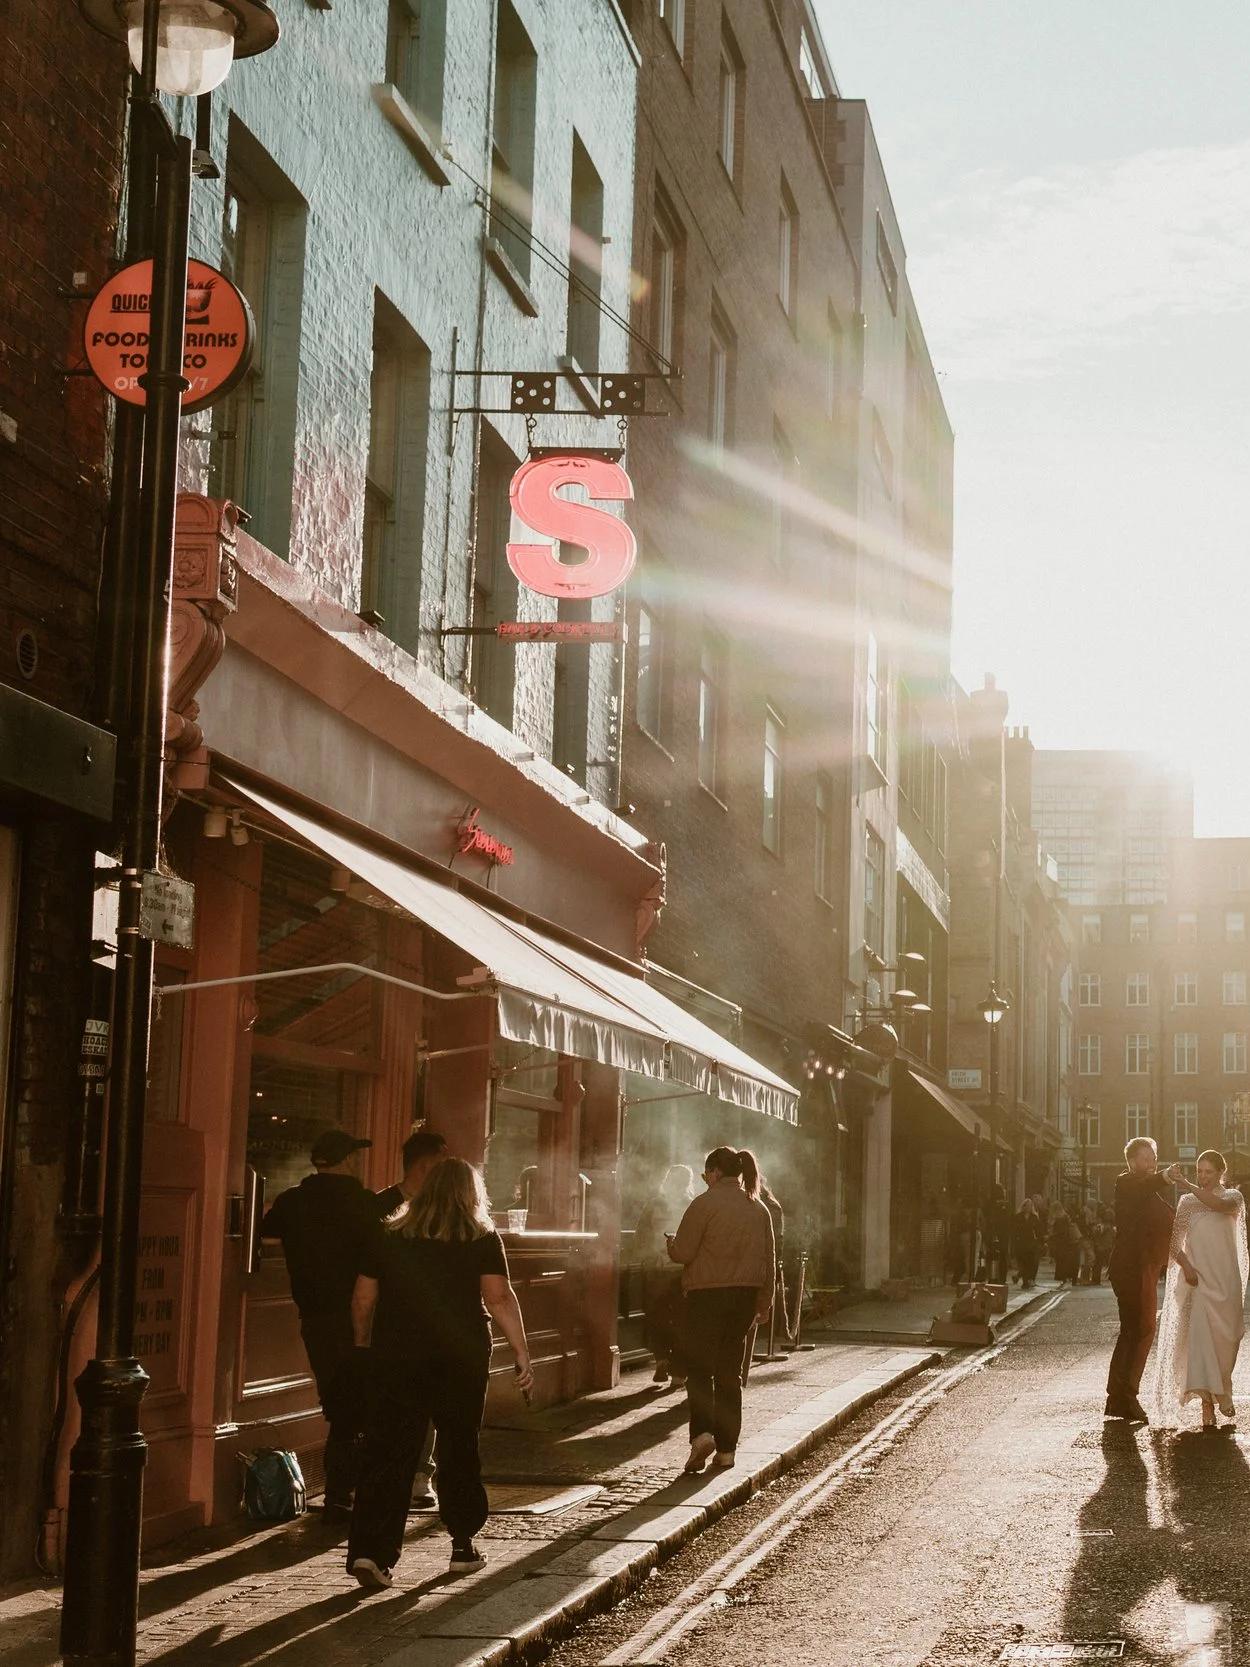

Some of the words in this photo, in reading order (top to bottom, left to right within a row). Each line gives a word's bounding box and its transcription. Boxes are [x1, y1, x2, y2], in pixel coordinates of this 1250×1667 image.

[111, 293, 153, 311] QUIC
[184, 332, 238, 348] RINKS
[120, 353, 207, 369] TOCO
[506, 456, 637, 599] S
[136, 1236, 157, 1258] APPY
